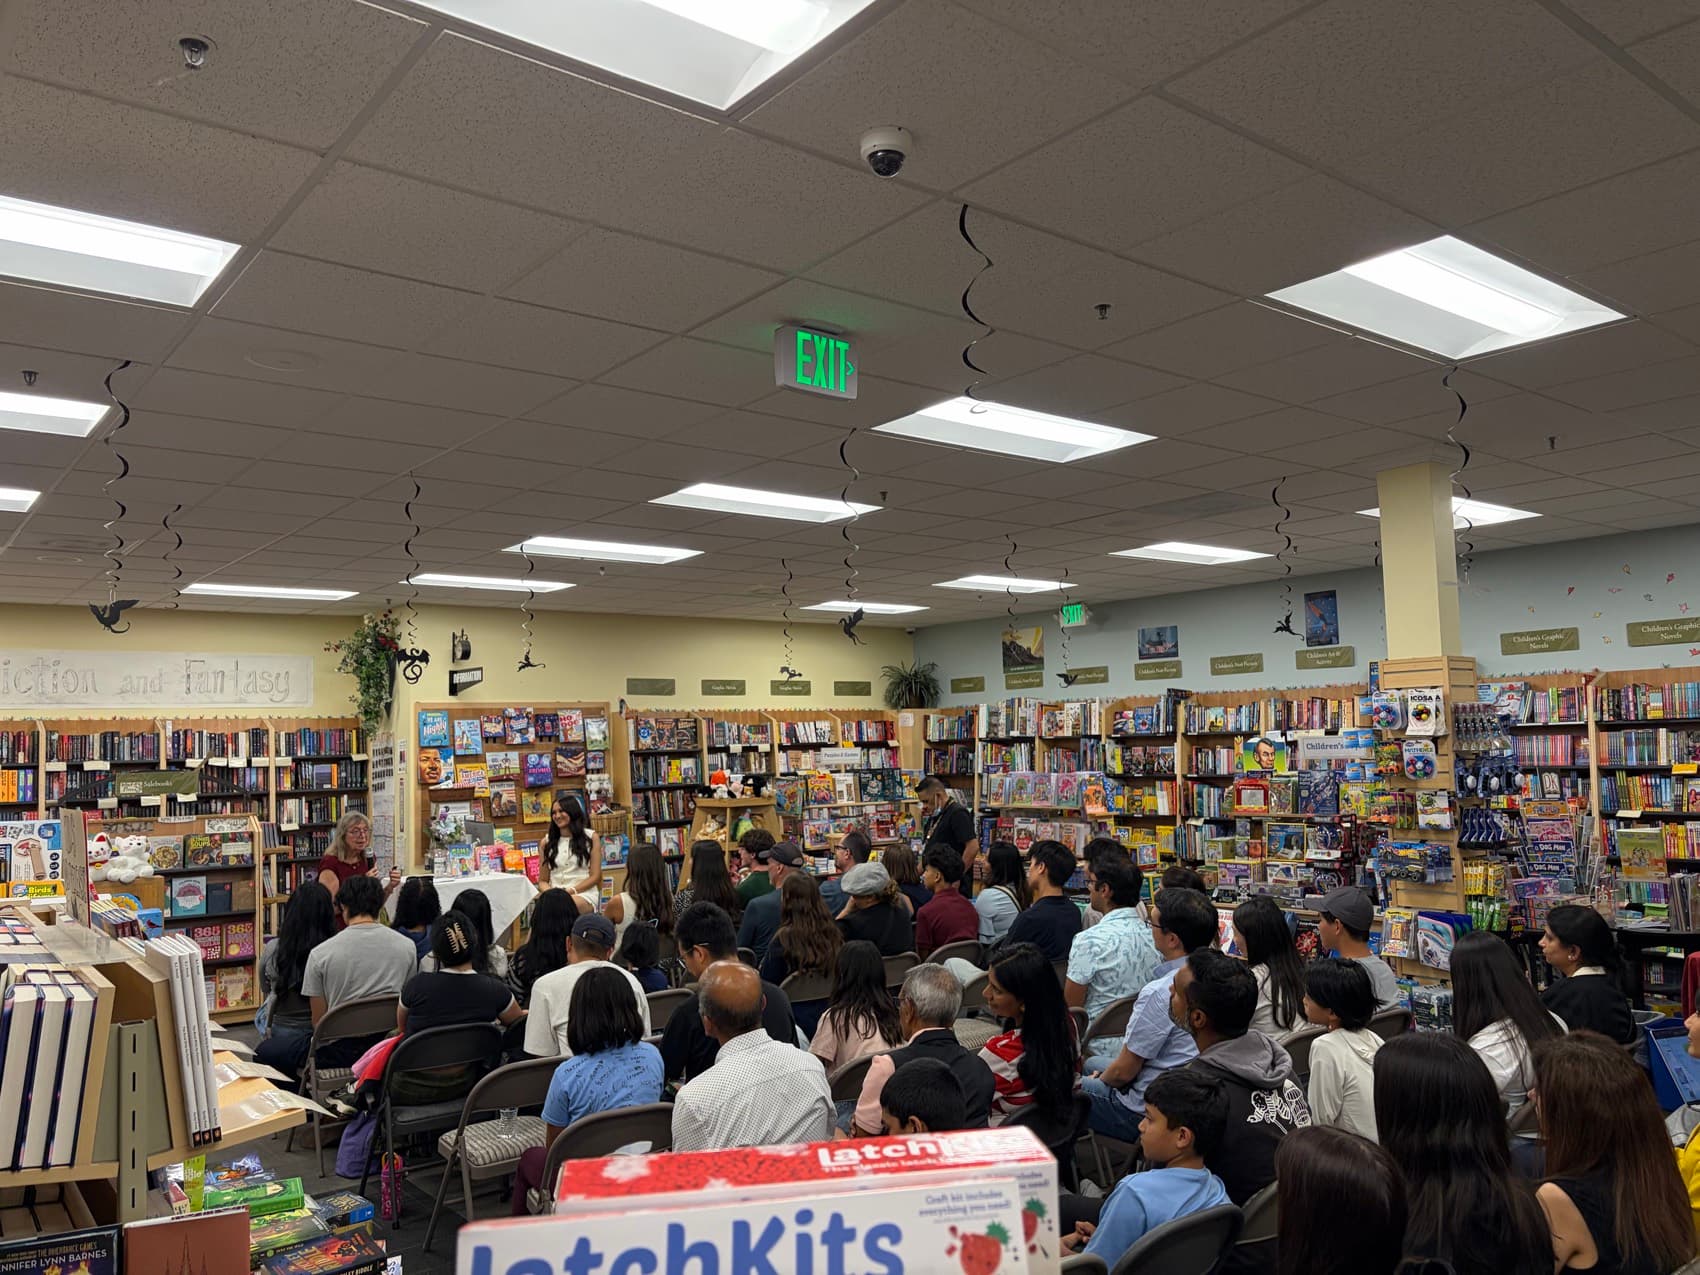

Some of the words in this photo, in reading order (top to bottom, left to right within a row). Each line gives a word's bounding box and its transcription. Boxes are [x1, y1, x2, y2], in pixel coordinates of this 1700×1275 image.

[797, 331, 849, 392] EXIT
[1062, 604, 1082, 625] EXIT
[1642, 624, 1673, 633] Children's
[1660, 632, 1682, 640] Novels
[1513, 634, 1541, 643] Children's
[184, 659, 290, 702] Fantasy
[453, 670, 482, 684] INFORMATION
[1306, 742, 1344, 750] Children's
[1542, 772, 1560, 791] DK
[926, 1193, 948, 1204] Craft
[951, 1192, 963, 1202] kit
[966, 1190, 1002, 1201] includes
[919, 1204, 967, 1217] everything
[969, 1204, 985, 1214] you
[988, 1200, 1011, 1209] need!
[0, 1260, 37, 1273] NNIFER
[40, 1255, 65, 1267] LYNN
[69, 1249, 107, 1263] BARNES
